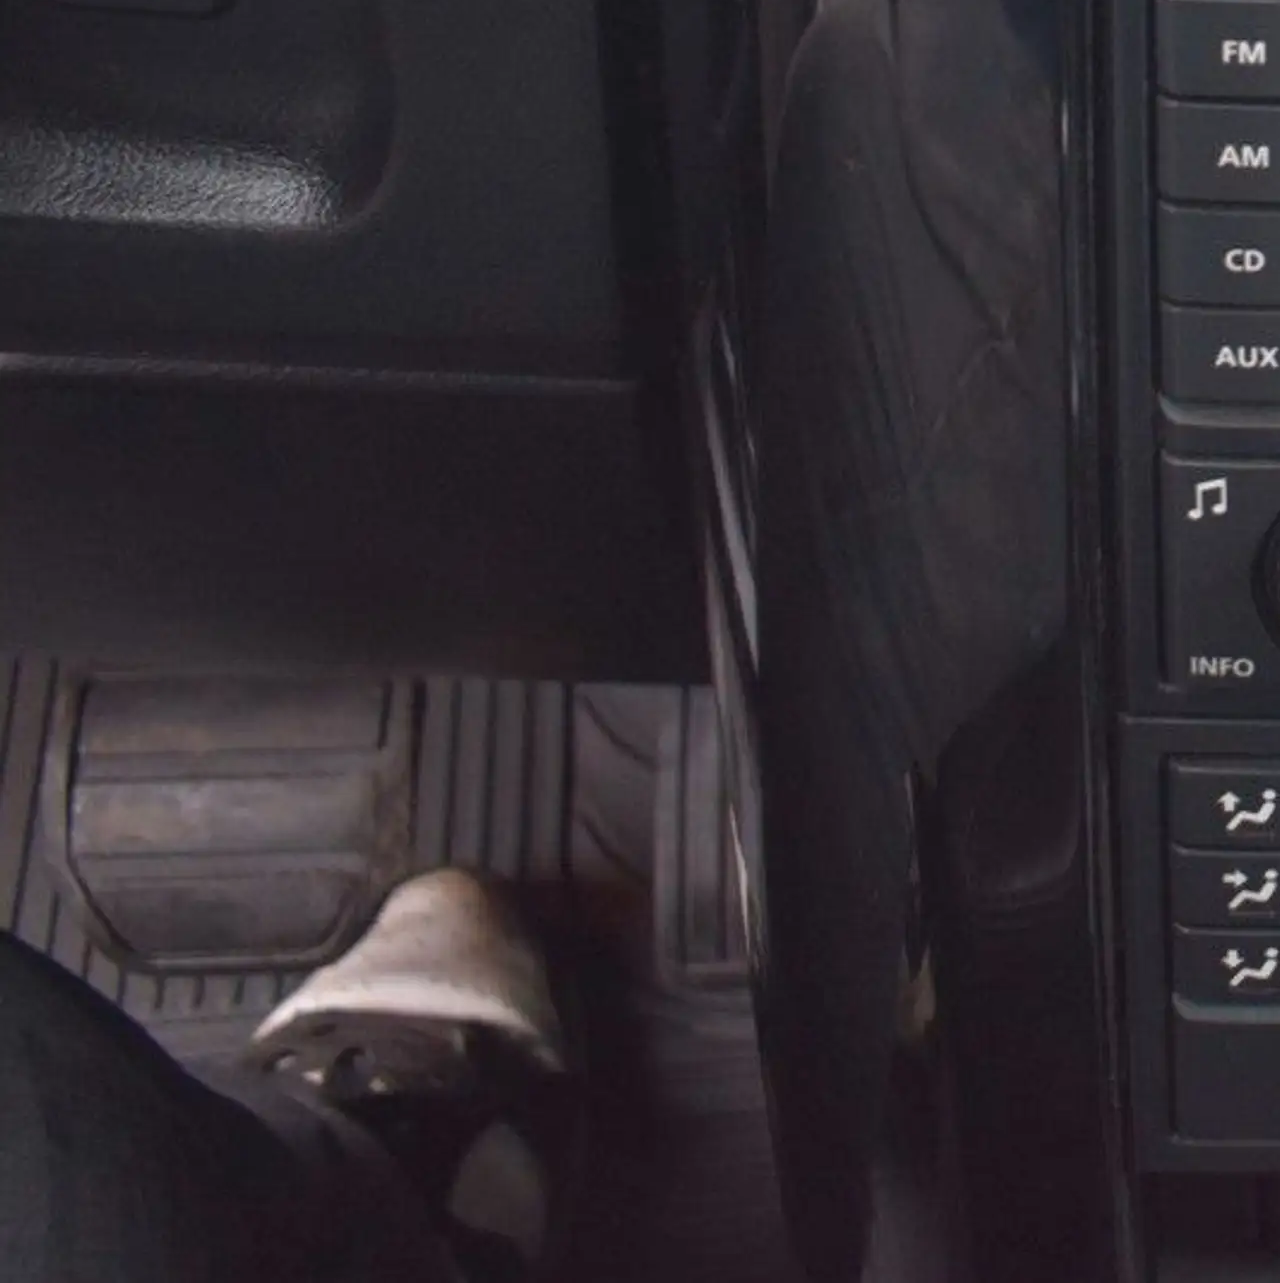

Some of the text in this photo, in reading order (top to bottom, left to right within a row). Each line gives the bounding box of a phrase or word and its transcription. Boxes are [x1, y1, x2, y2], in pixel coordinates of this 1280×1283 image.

[1222, 40, 1266, 64] FM
[1218, 145, 1270, 168] AM
[1224, 248, 1266, 272] CD
[1215, 346, 1279, 368] AUX
[1190, 656, 1255, 677] INFO
